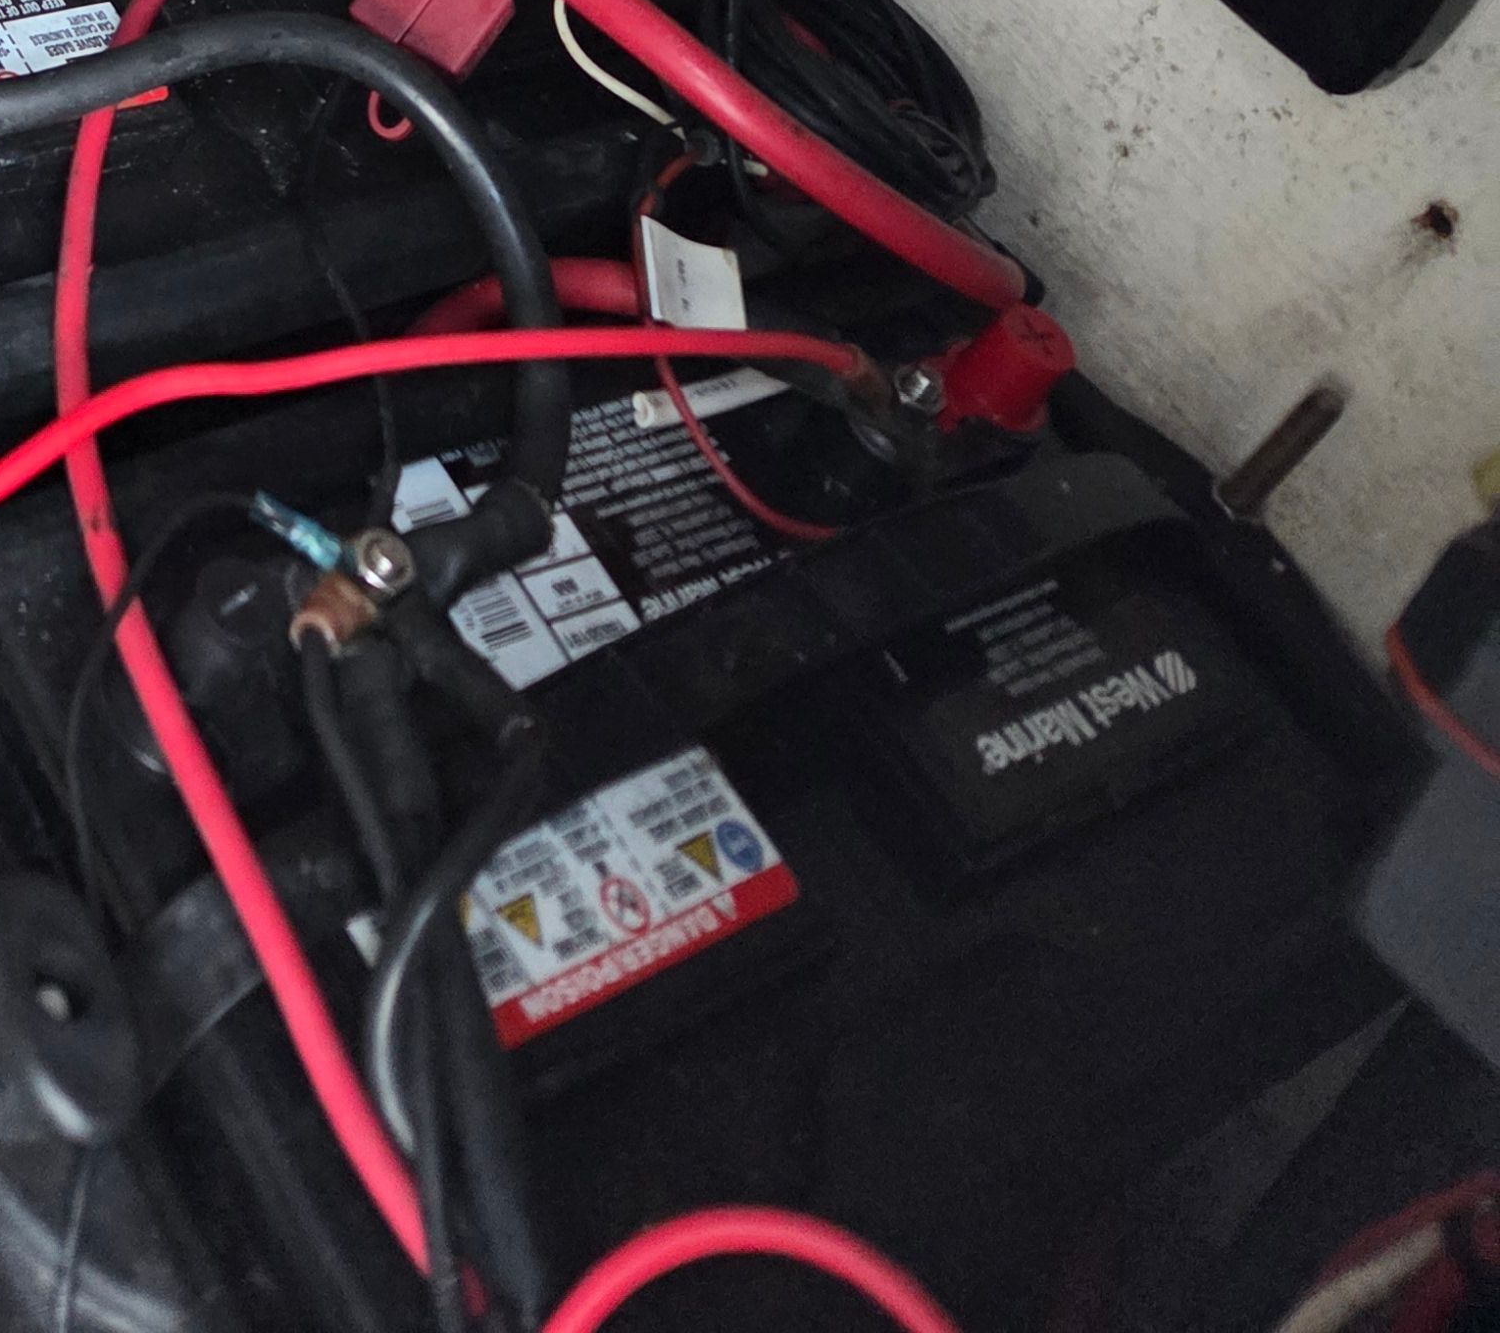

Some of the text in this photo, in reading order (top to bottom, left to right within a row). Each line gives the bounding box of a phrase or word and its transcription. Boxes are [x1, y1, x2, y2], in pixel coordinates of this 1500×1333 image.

[16, 0, 41, 15] OUT
[1076, 663, 1173, 728] West
[972, 698, 1098, 776] Marine
